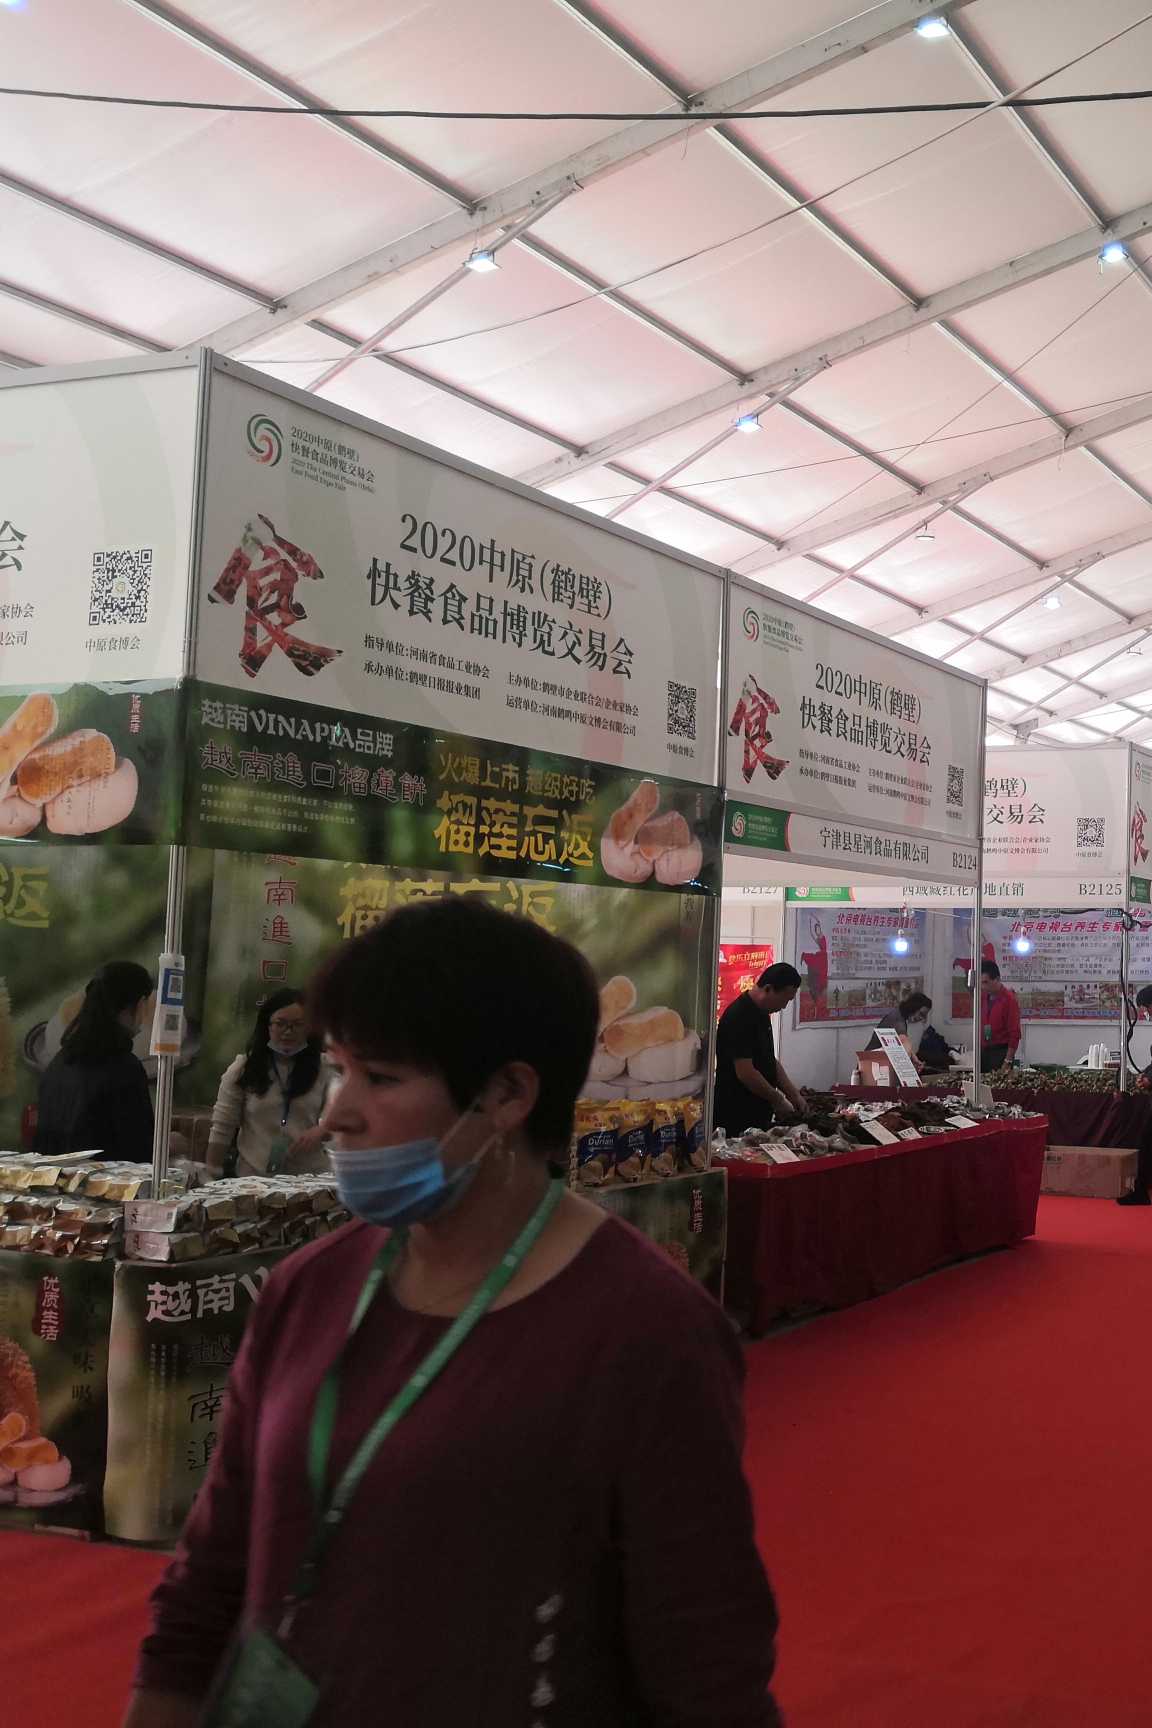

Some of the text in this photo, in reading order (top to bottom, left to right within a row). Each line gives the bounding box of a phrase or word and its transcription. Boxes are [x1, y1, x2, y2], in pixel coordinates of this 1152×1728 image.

[400, 513, 612, 620] 2020中原(鹤壁)
[85, 636, 141, 653] 中原食博会
[367, 557, 635, 679] 快餐食品博览交易会
[815, 663, 921, 725] 2020中原(鹤壁)
[800, 695, 931, 767] 快餐食品博览交易会
[439, 753, 520, 793] 火爆上市
[433, 790, 595, 867] 榴莲忘返
[986, 803, 1046, 825] 交易会
[819, 826, 977, 871] 宁津县星河食品有限公司 B2124
[1079, 884, 1122, 896] B2125
[40, 1275, 60, 1341] 优质生活
